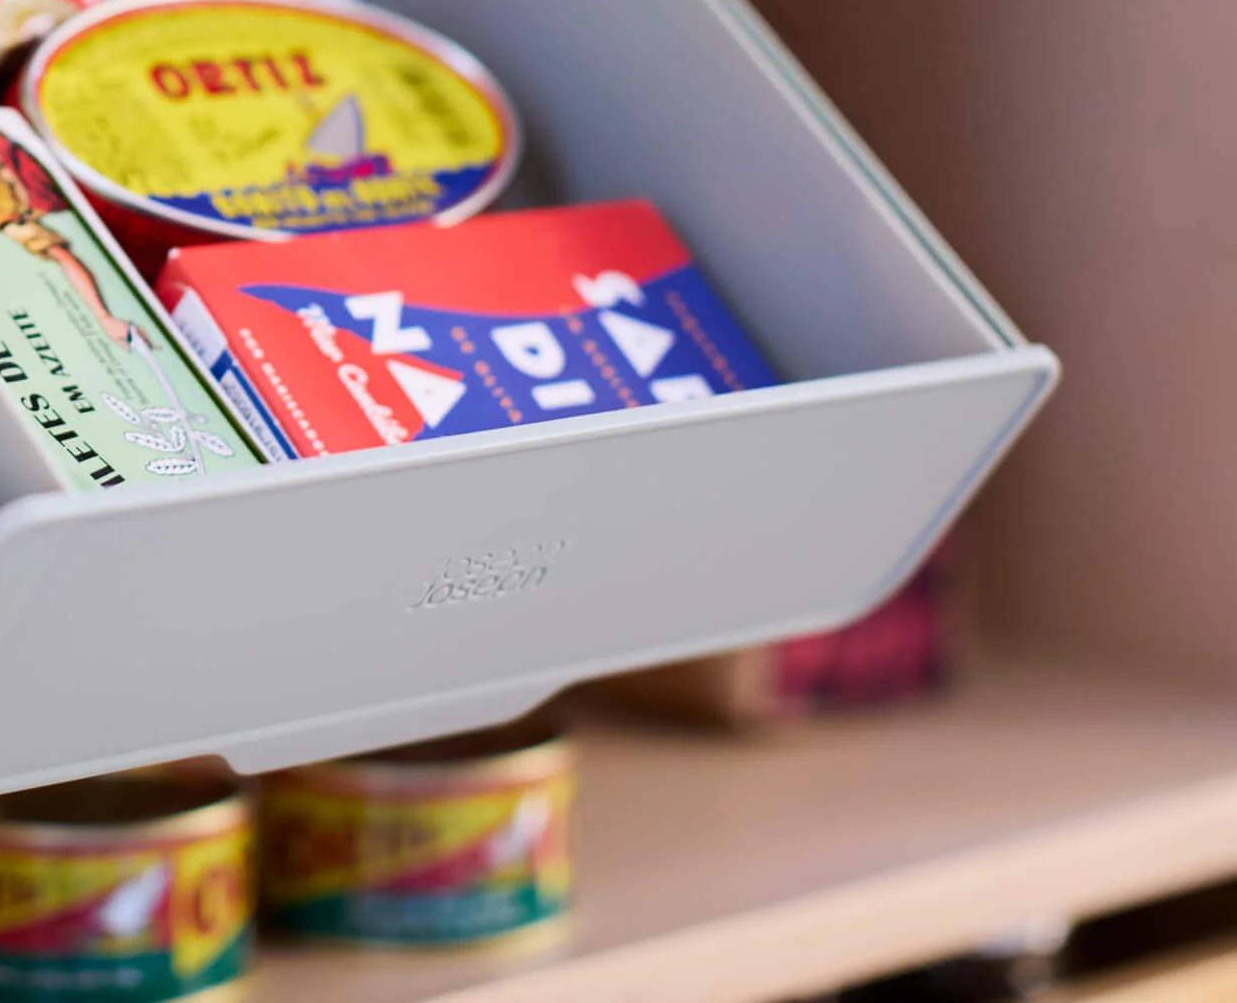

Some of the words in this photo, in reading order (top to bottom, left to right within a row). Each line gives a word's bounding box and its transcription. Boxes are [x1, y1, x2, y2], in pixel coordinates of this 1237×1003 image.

[150, 51, 325, 101] ORTIZ
[7, 307, 72, 379] AZEITE
[345, 290, 466, 429] NA
[490, 322, 595, 411] DI
[55, 384, 95, 415] EM
